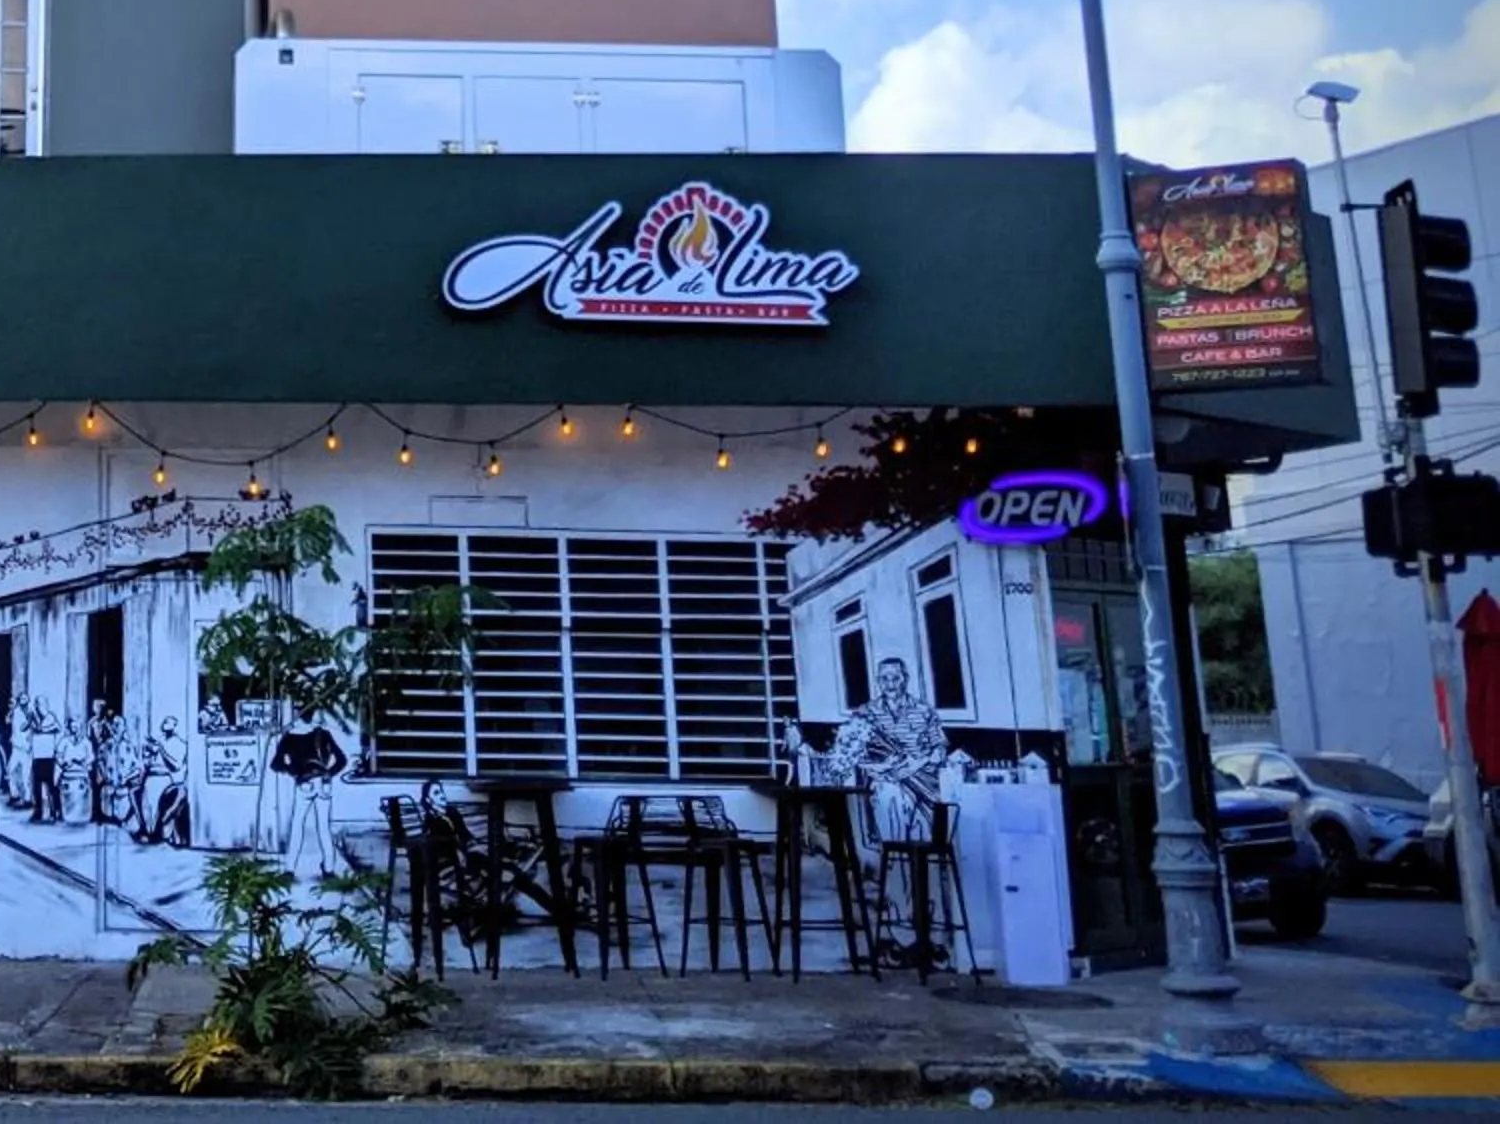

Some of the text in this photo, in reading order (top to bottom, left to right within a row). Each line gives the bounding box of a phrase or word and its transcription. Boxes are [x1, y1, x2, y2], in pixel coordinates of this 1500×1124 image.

[444, 204, 858, 311] Asia de Lima
[600, 303, 650, 313] PIZZA
[680, 305, 734, 315] PASTA
[1156, 304, 1207, 318] PIZZA
[1225, 301, 1247, 313] LA
[1156, 325, 1313, 346] PASTAS BRUNCH
[1245, 347, 1282, 360] BAR
[976, 489, 1086, 528] OPEN
